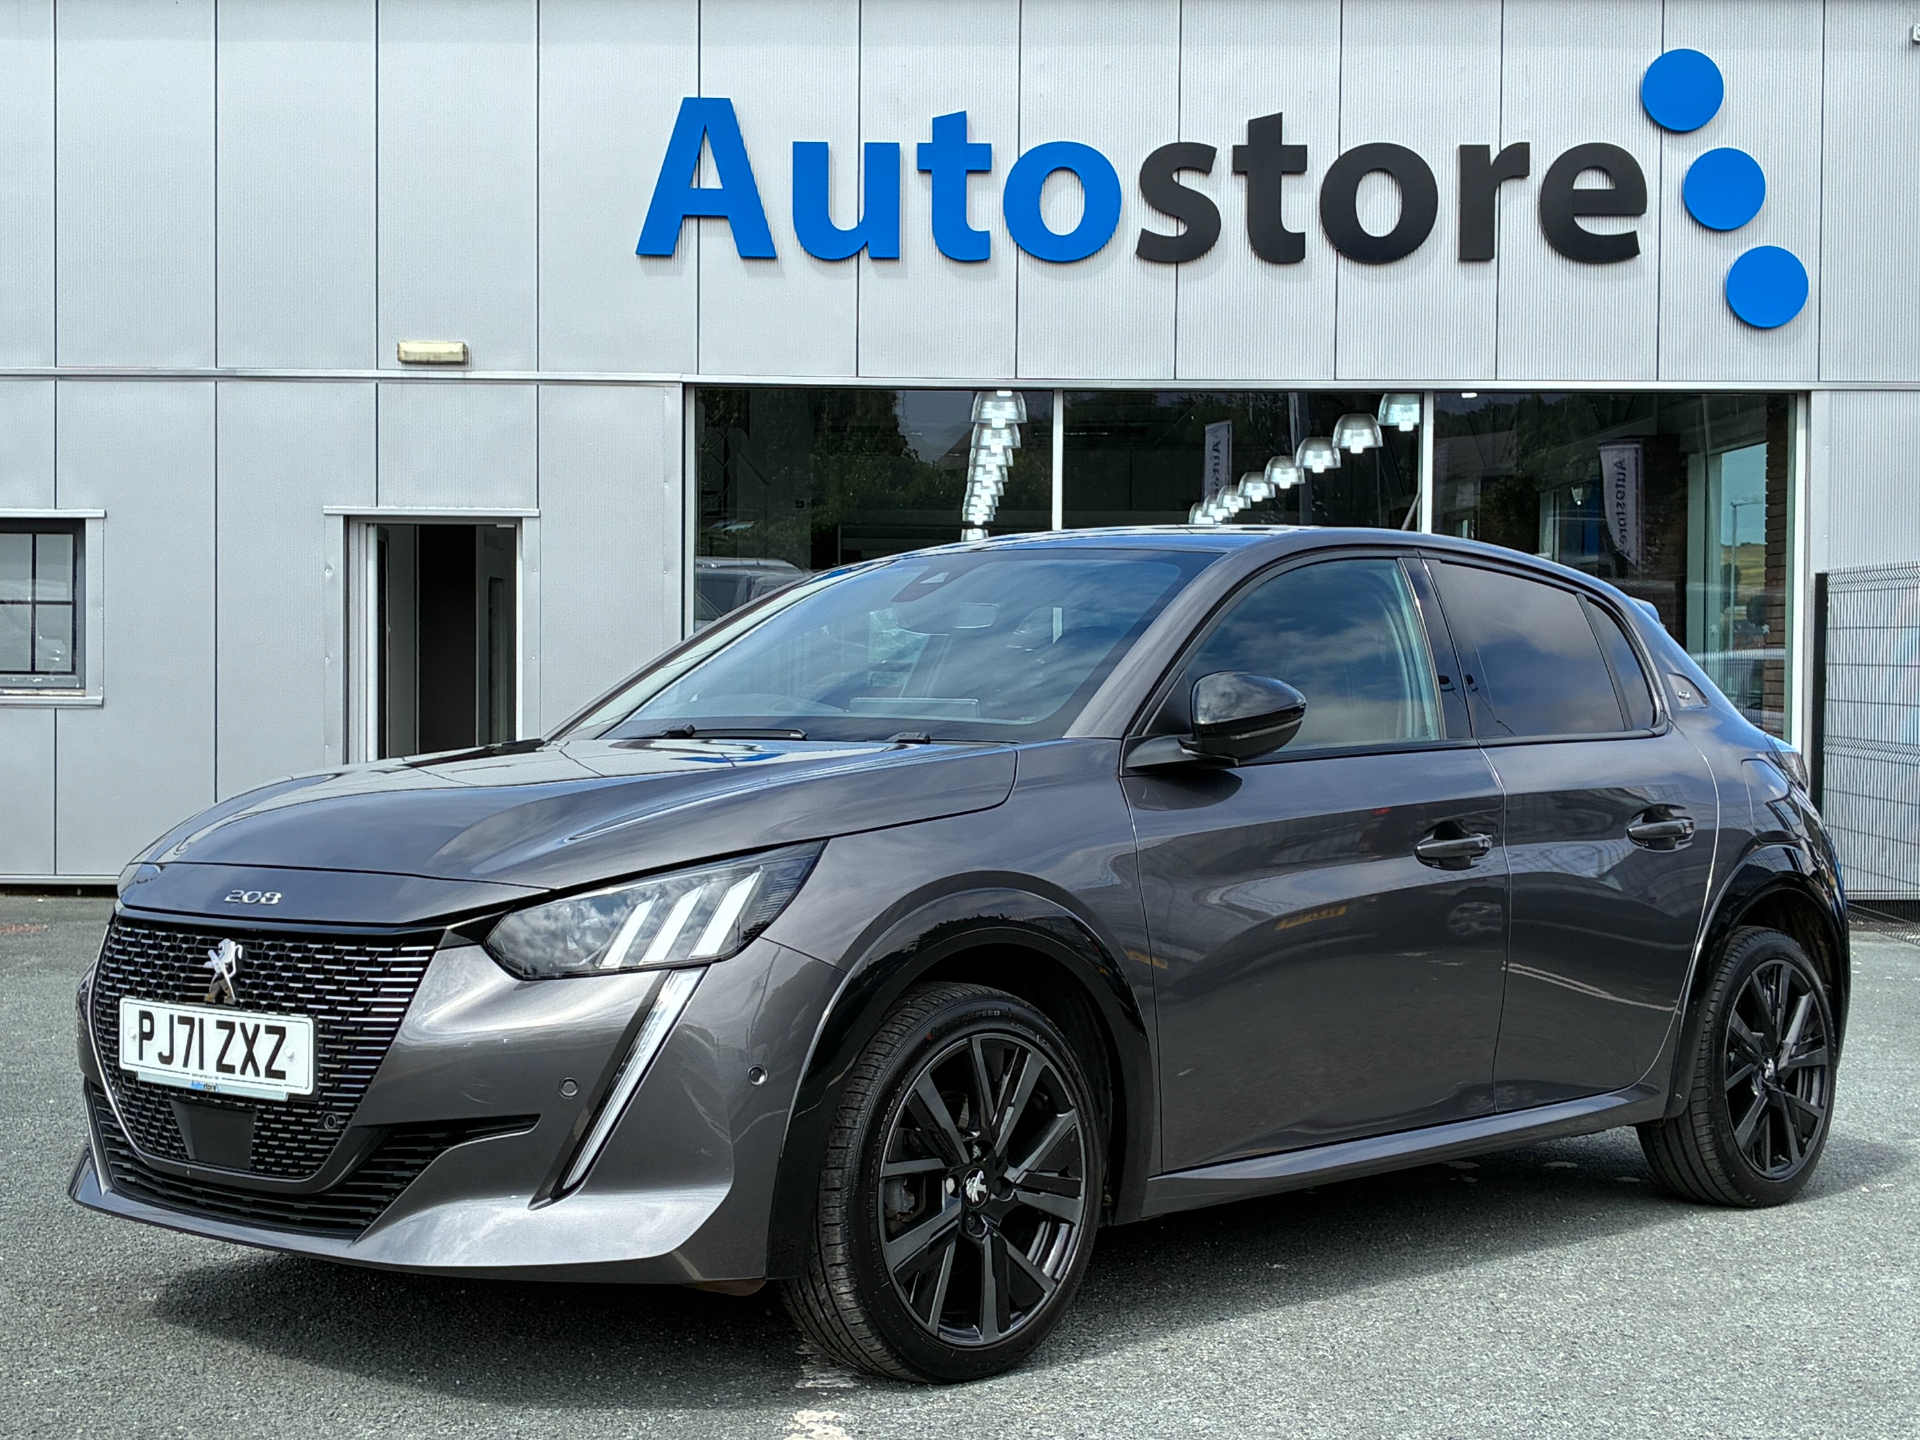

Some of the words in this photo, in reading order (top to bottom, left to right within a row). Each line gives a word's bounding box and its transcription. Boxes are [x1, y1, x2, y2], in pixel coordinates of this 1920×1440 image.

[636, 97, 1647, 263] Autostore
[223, 889, 282, 905] 208
[138, 1009, 204, 1070] PJ71
[216, 1019, 286, 1081] ZXZ
